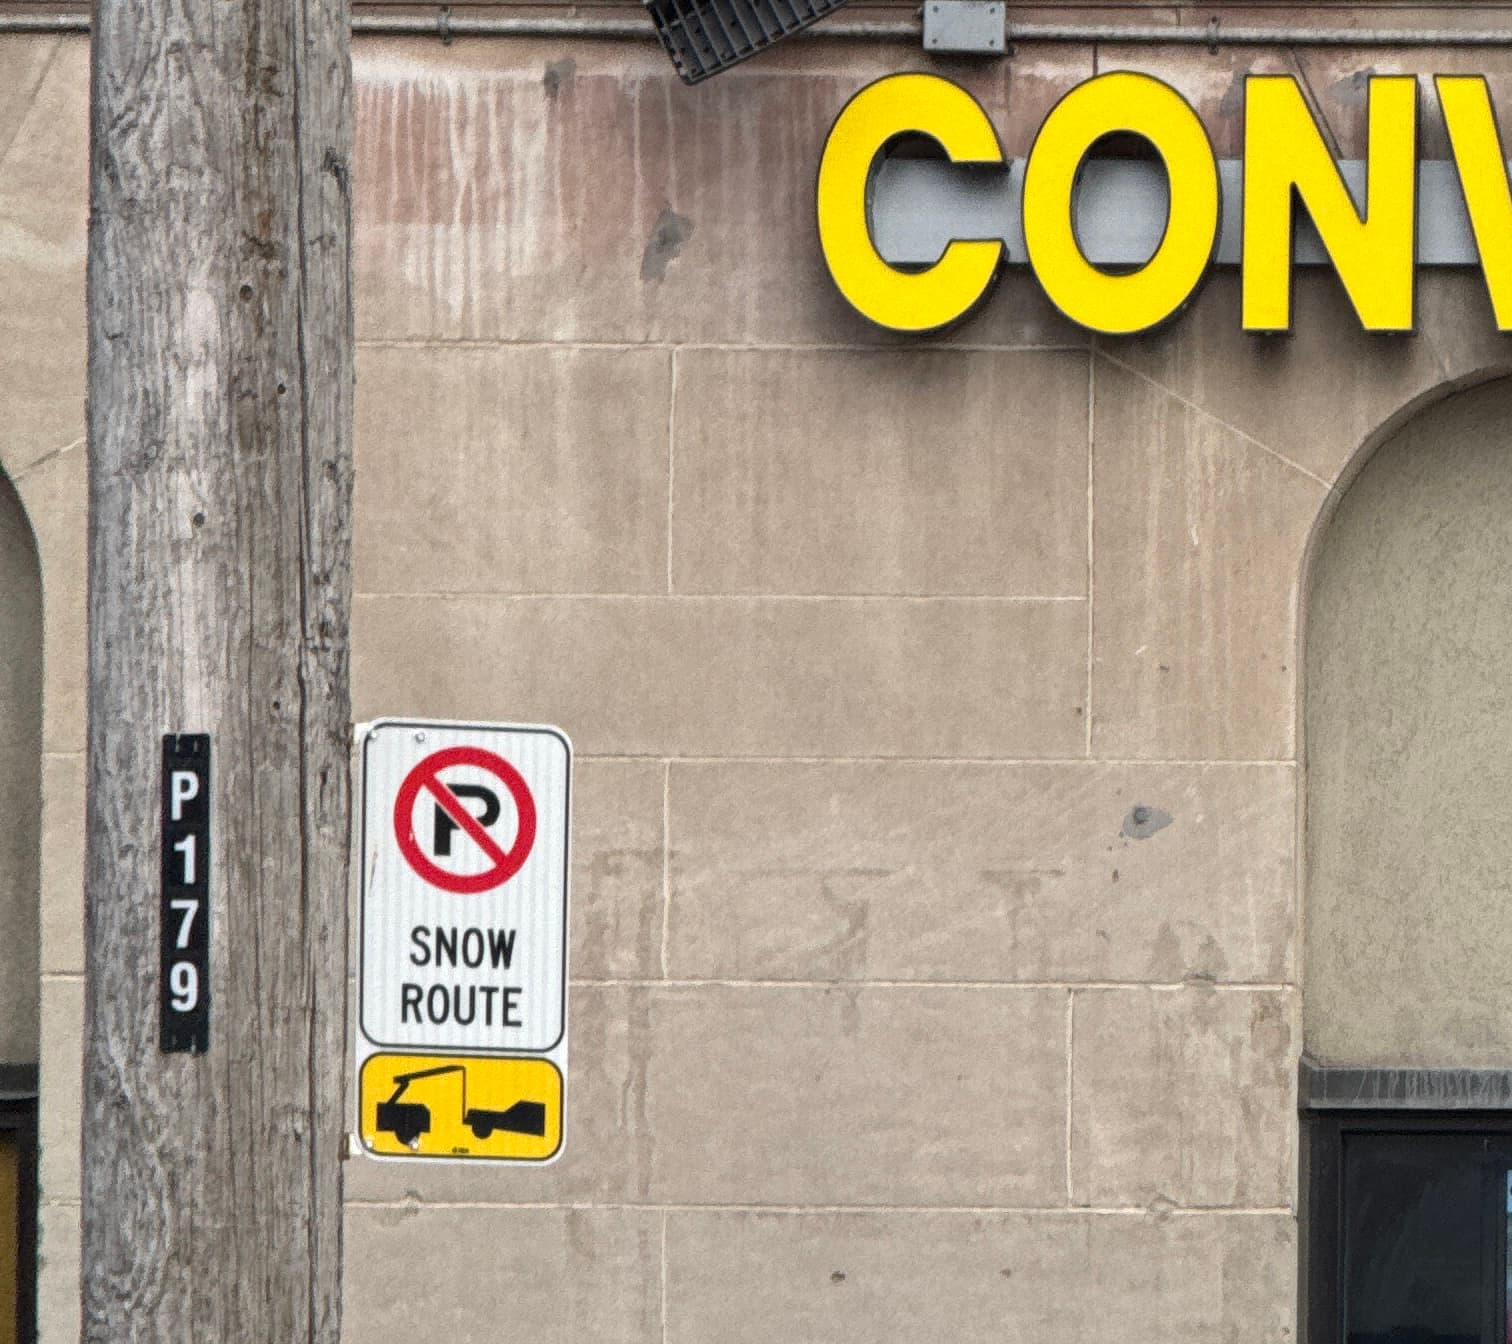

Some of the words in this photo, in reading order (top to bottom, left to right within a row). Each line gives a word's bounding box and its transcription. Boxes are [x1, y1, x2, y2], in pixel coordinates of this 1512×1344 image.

[169, 770, 200, 1013] P179
[409, 925, 517, 970] SNOW
[400, 983, 523, 1028] ROUTE
